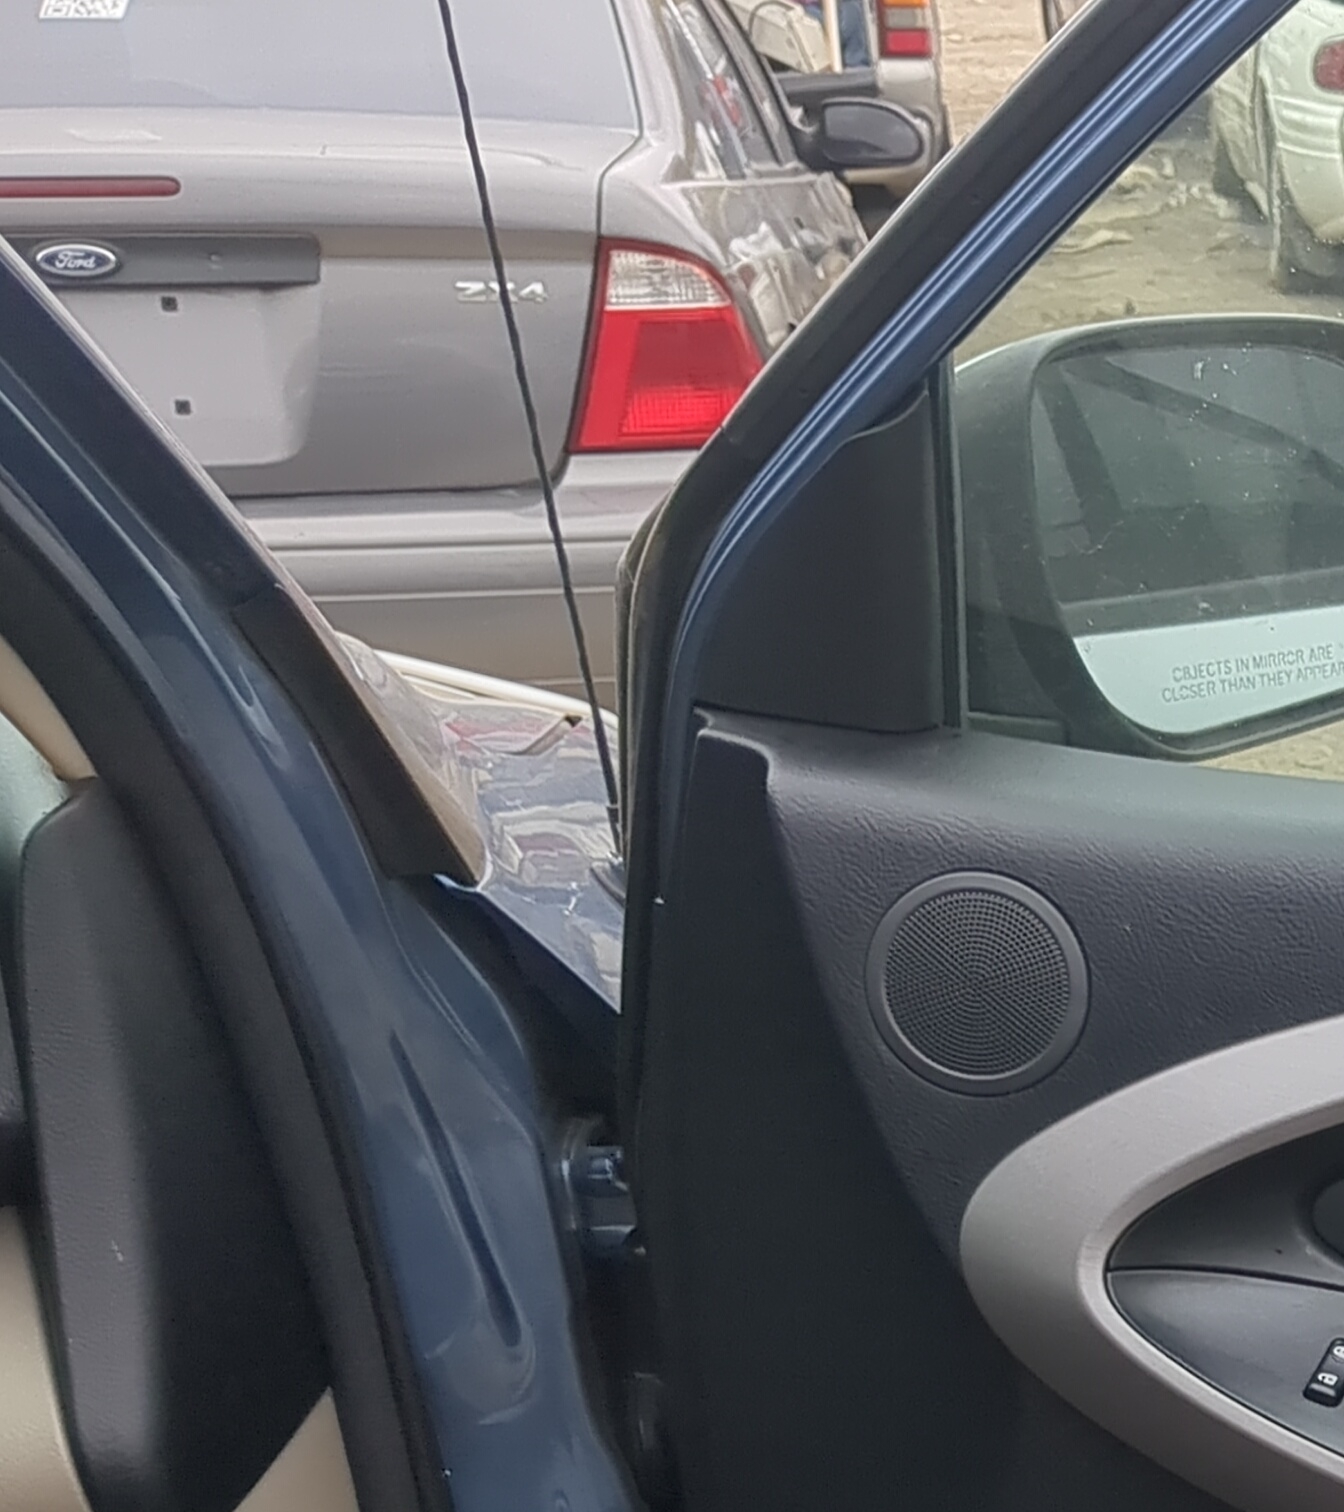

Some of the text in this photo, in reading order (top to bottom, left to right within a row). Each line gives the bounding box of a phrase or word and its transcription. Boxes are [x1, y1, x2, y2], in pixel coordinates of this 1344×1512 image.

[54, 251, 97, 270] Ford
[1235, 658, 1250, 673] IN
[1308, 644, 1334, 662] ARE
[1220, 676, 1256, 693] THAN
[1259, 670, 1294, 687] THEY
